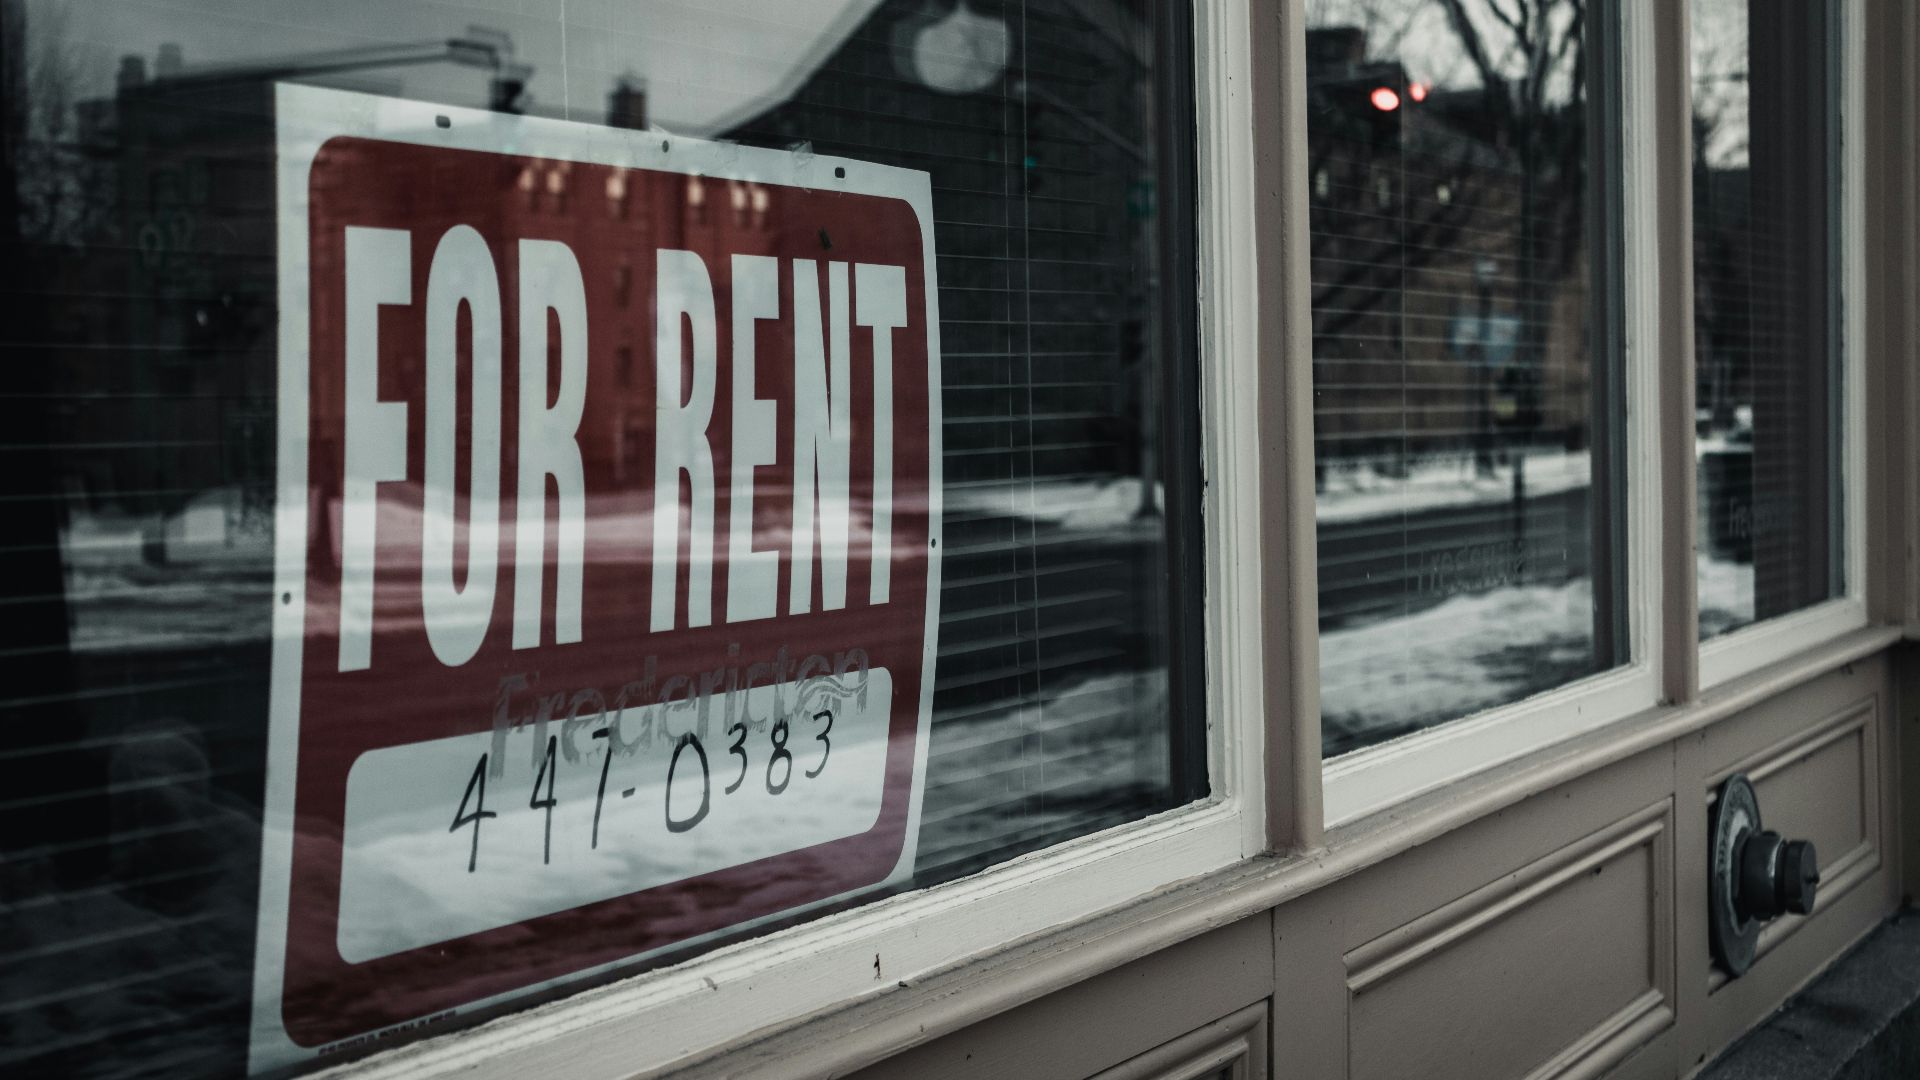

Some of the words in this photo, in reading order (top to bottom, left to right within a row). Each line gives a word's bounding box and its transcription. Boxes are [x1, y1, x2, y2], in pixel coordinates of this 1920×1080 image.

[338, 224, 588, 672] FOR
[650, 248, 908, 633] RENT
[448, 709, 834, 873] 447-0383
[489, 643, 869, 779] Fredericton
